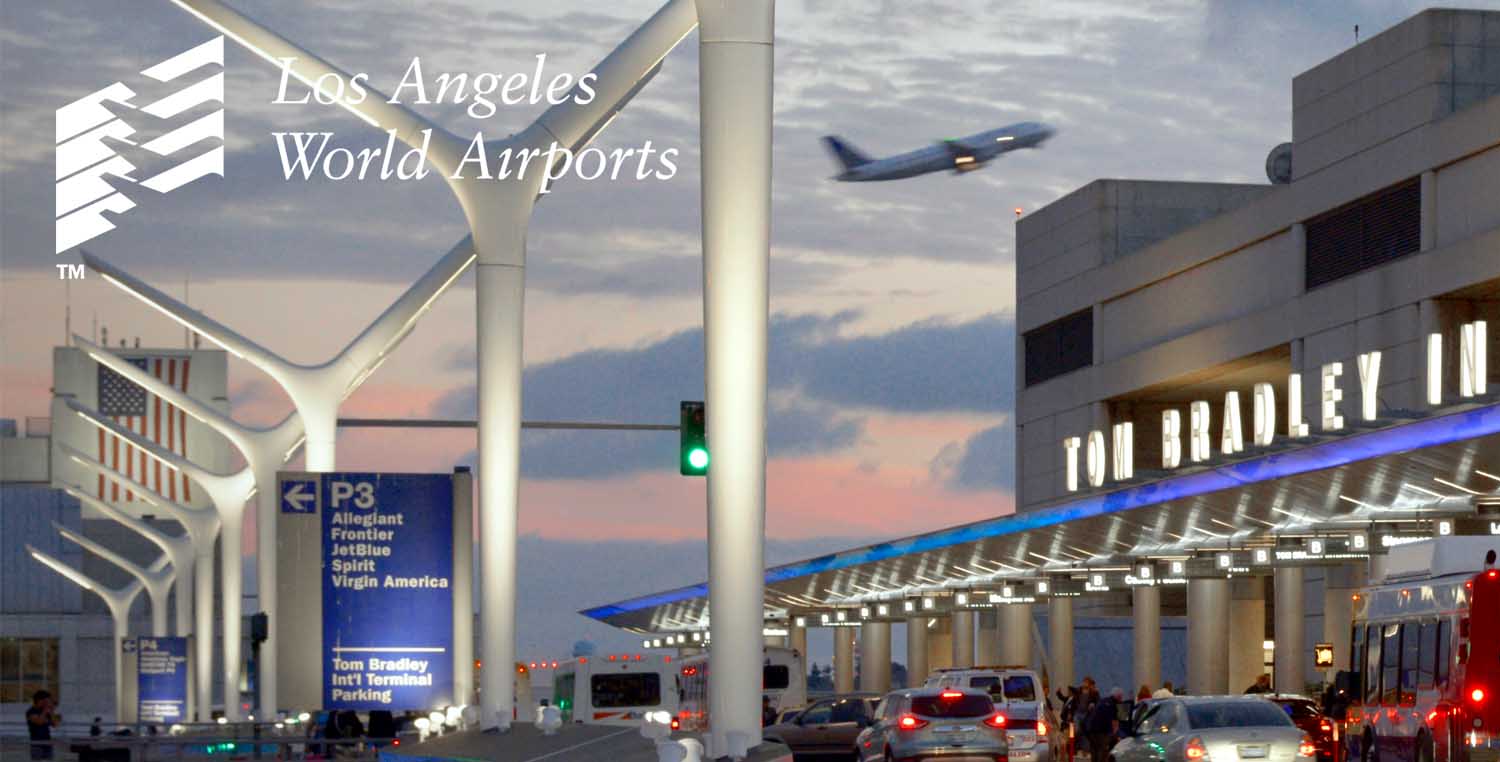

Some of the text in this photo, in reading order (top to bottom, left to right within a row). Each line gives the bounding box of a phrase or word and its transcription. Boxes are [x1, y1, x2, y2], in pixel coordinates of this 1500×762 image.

[1064, 422, 1133, 492] TOM
[1161, 351, 1382, 469] BRADLEY
[331, 481, 376, 509] P3
[332, 511, 404, 527] Allegiant
[331, 527, 395, 541] Frontier
[1439, 521, 1451, 535] B
[1311, 541, 1322, 554] B
[1354, 535, 1365, 549] B
[331, 543, 392, 557] JetBlue
[331, 559, 376, 574] Spirit
[332, 574, 449, 590] Virgin America
[332, 657, 429, 673] Tom Bradley
[332, 673, 433, 686] Int'l Terminal
[332, 688, 392, 704] Parking
